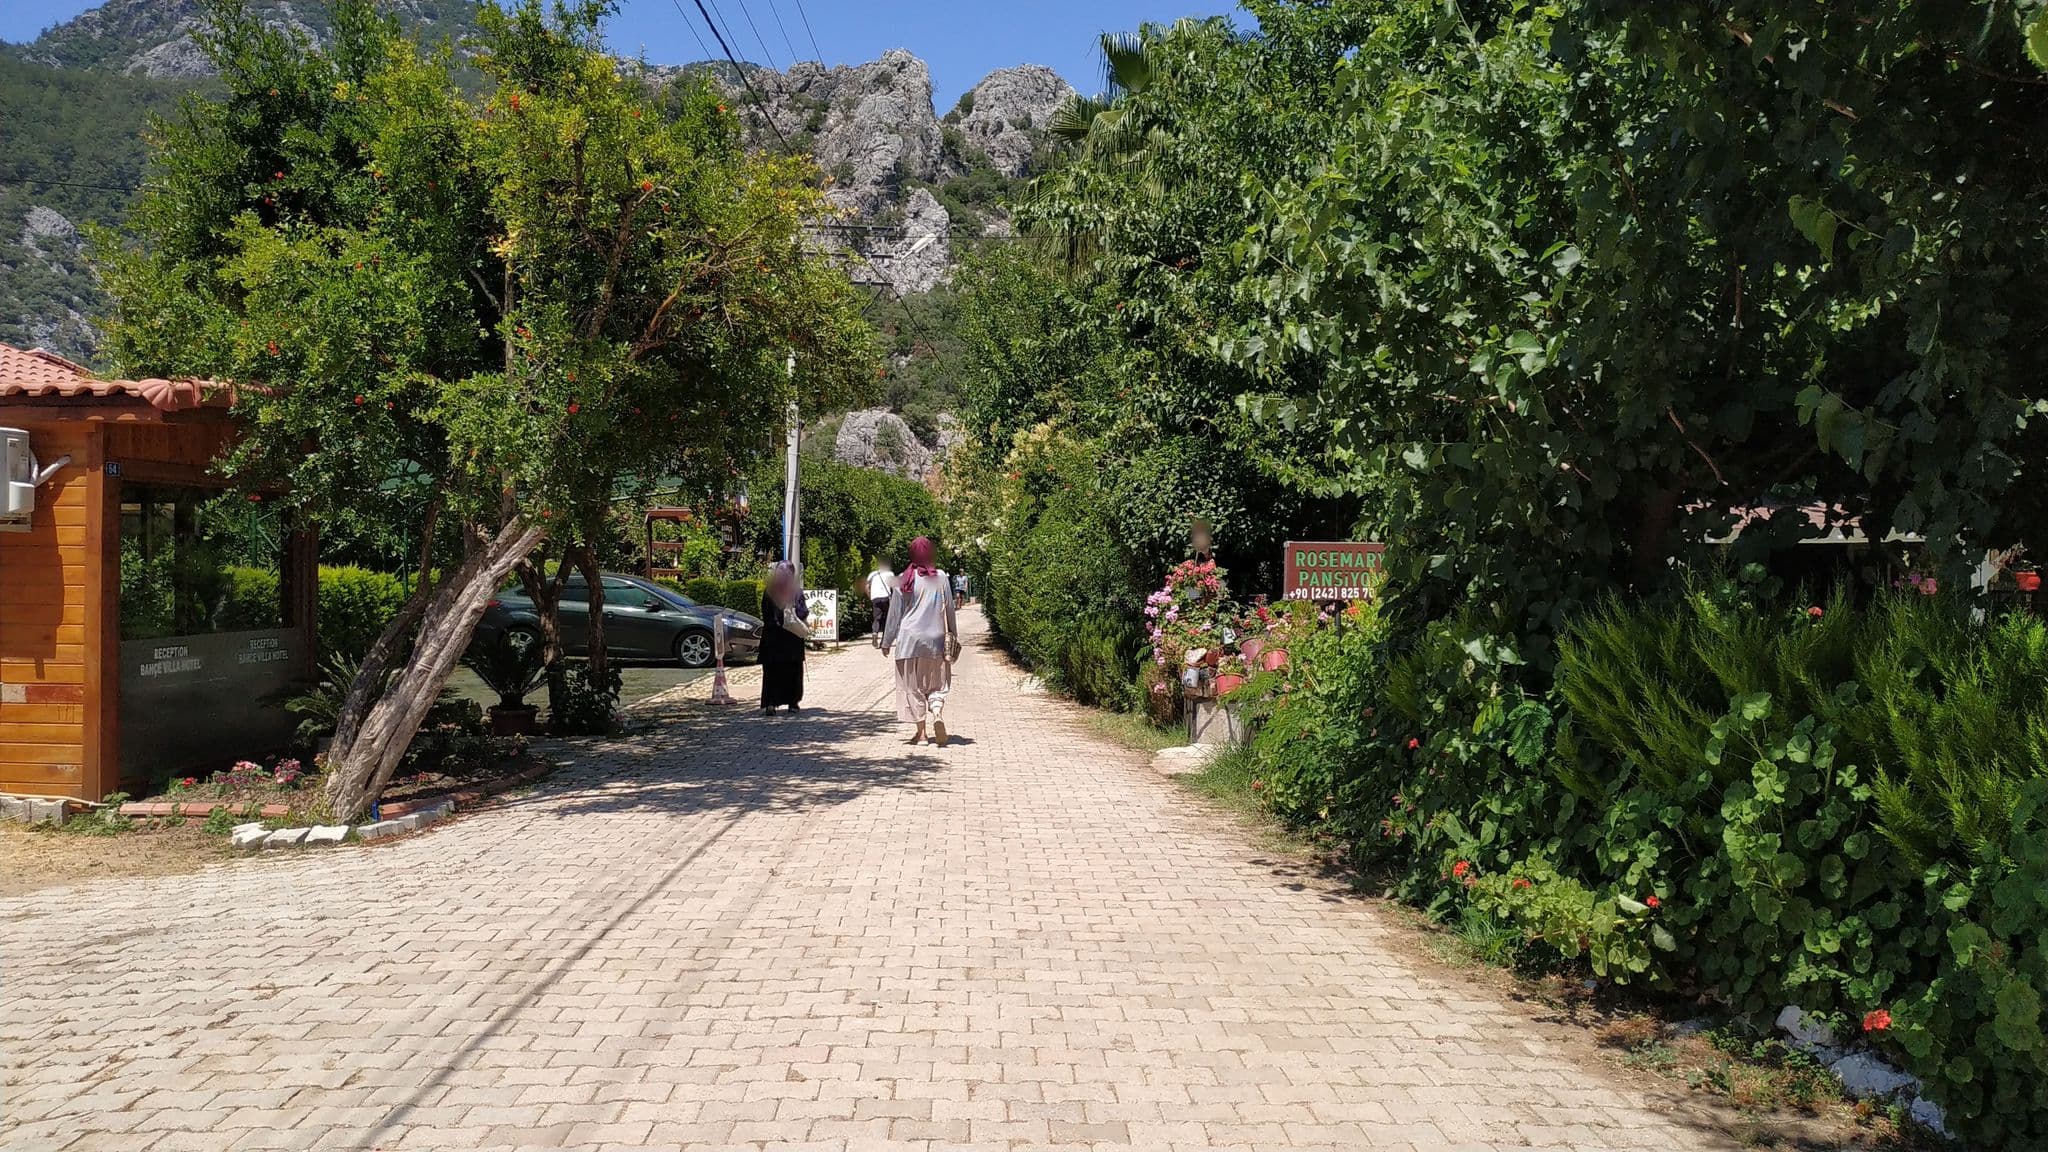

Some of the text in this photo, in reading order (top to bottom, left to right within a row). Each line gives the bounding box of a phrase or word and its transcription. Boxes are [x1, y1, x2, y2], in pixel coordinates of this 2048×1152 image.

[1295, 551, 1386, 568] ROSEMARY
[803, 590, 835, 601] BAHÇE
[1289, 588, 1308, 599] +90
[1311, 587, 1338, 600] (242)
[1341, 587, 1360, 599] 825
